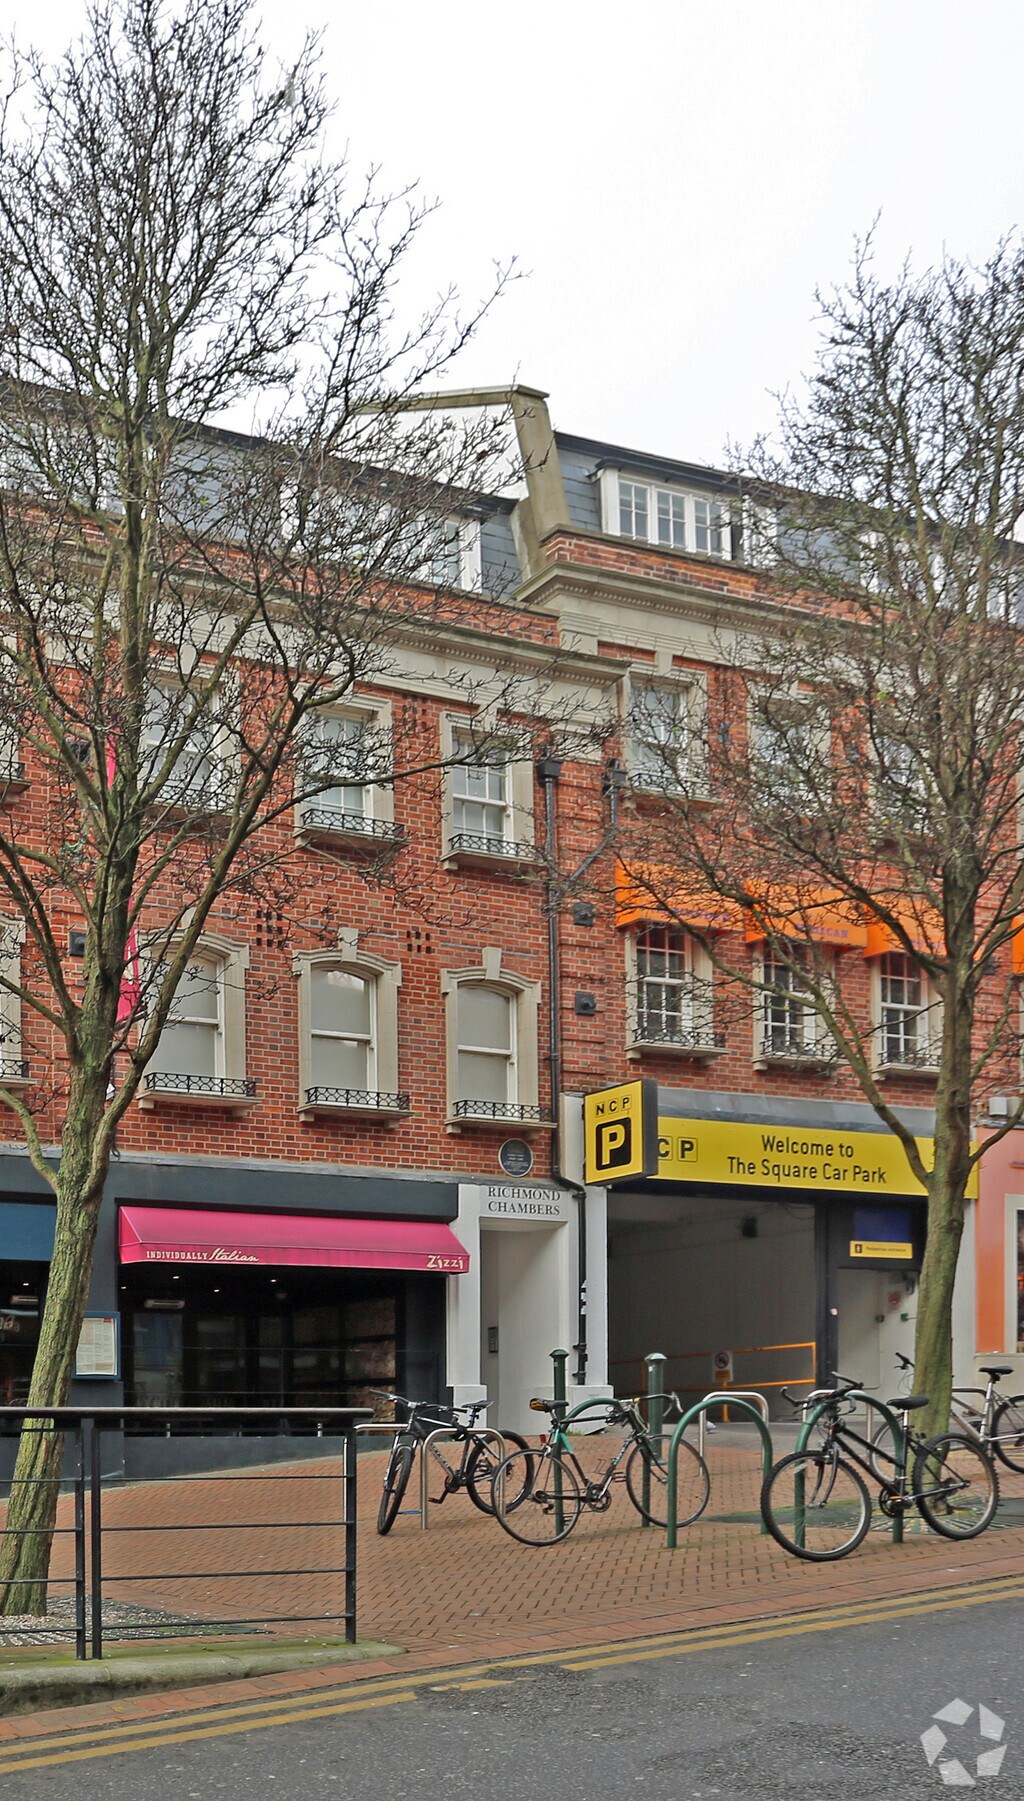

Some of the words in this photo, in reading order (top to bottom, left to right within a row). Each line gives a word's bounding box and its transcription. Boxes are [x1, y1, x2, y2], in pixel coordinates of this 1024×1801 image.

[596, 1097, 630, 1116] NCP
[602, 1124, 626, 1166] P
[658, 1138, 695, 1159] CP
[761, 1134, 834, 1157] Welcome
[838, 1143, 855, 1158] to
[727, 1156, 757, 1175] The
[761, 1159, 818, 1183] Square
[823, 1163, 849, 1182] Car
[853, 1165, 887, 1184] Park
[488, 1186, 561, 1202] RICHMOND
[488, 1201, 561, 1216] CHAMBERS
[146, 1250, 208, 1260] INDIVIDUALLY
[208, 1247, 260, 1262] Italian
[426, 1254, 464, 1270] Zizzi
